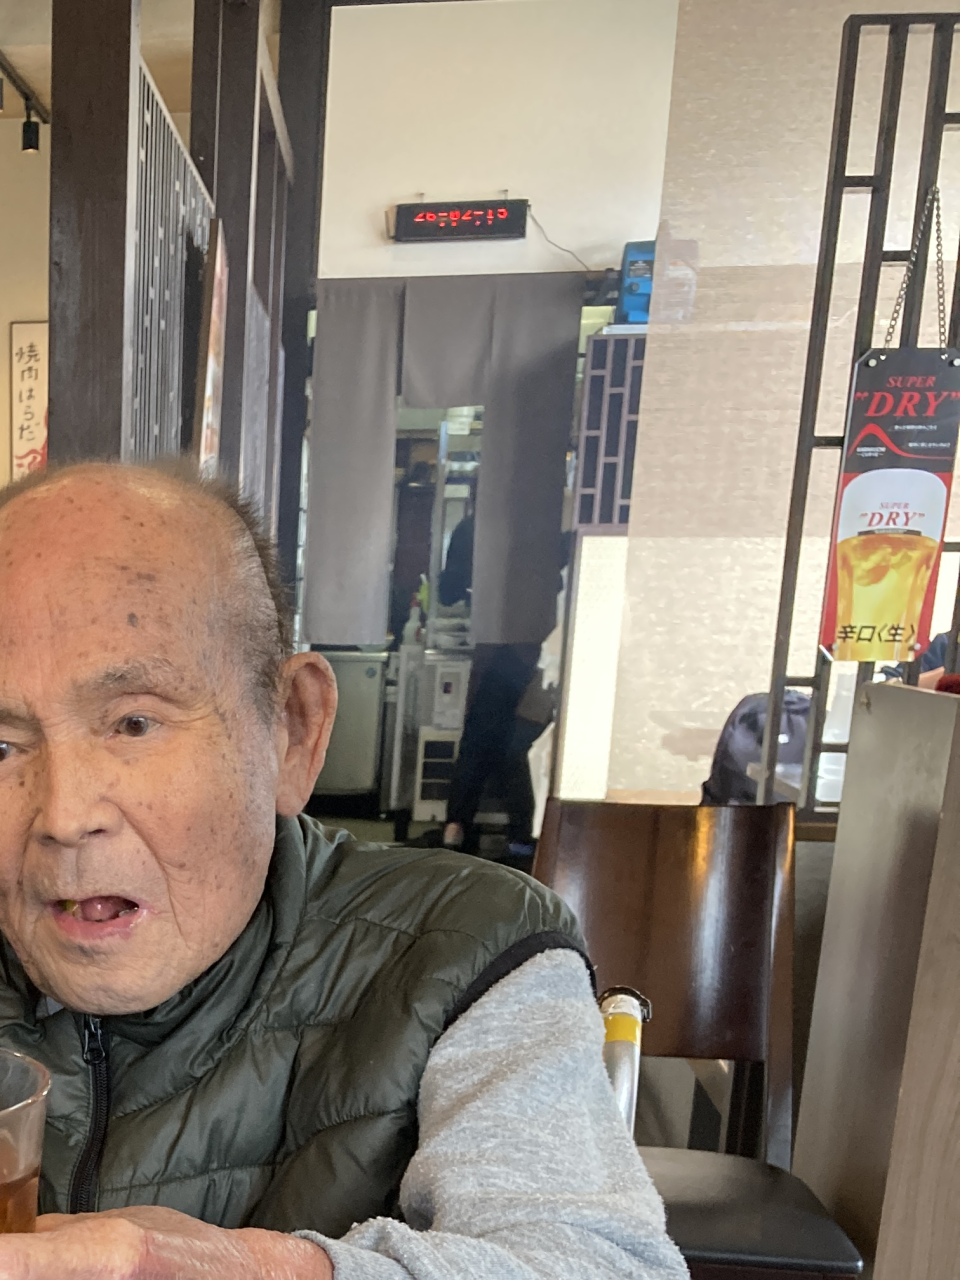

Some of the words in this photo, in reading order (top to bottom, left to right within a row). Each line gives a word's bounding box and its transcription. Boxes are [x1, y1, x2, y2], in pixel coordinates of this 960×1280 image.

[14, 341, 41, 442] 焼肉はらだ
[886, 376, 937, 388] SUPER
